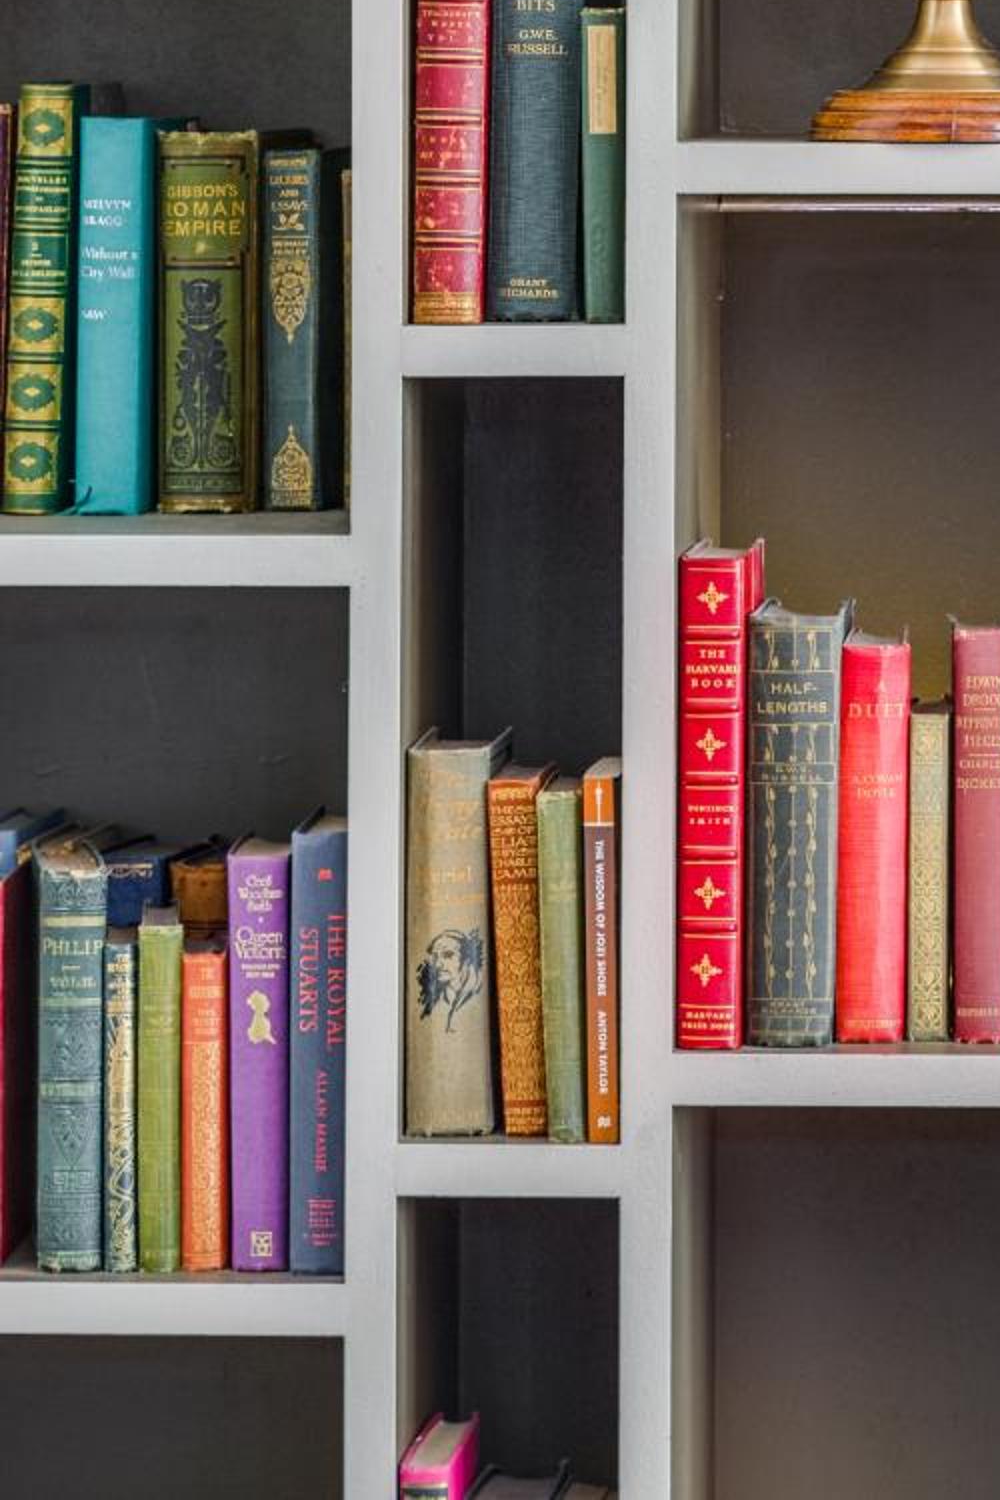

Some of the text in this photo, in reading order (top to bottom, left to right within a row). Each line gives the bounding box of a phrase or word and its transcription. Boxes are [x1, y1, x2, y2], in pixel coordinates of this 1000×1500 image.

[167, 183, 239, 197] GIBBON'S
[165, 220, 241, 237] EMPIRE
[510, 277, 547, 286] GRANT
[699, 650, 725, 659] THE
[691, 679, 737, 688] BOOK
[769, 682, 818, 695] HALF-
[757, 701, 828, 715] LENGTHS
[848, 703, 904, 719] DUET
[595, 840, 604, 861] THE
[595, 863, 605, 910] WISDOM
[595, 913, 605, 929] OF
[235, 925, 283, 944] Queen
[43, 938, 104, 956] PHILIP
[299, 928, 319, 1033] STUARTS
[327, 914, 345, 1046] THE ROYAL
[598, 960, 607, 996] SHORE
[598, 1010, 608, 1094] ANTON TAYLOR
